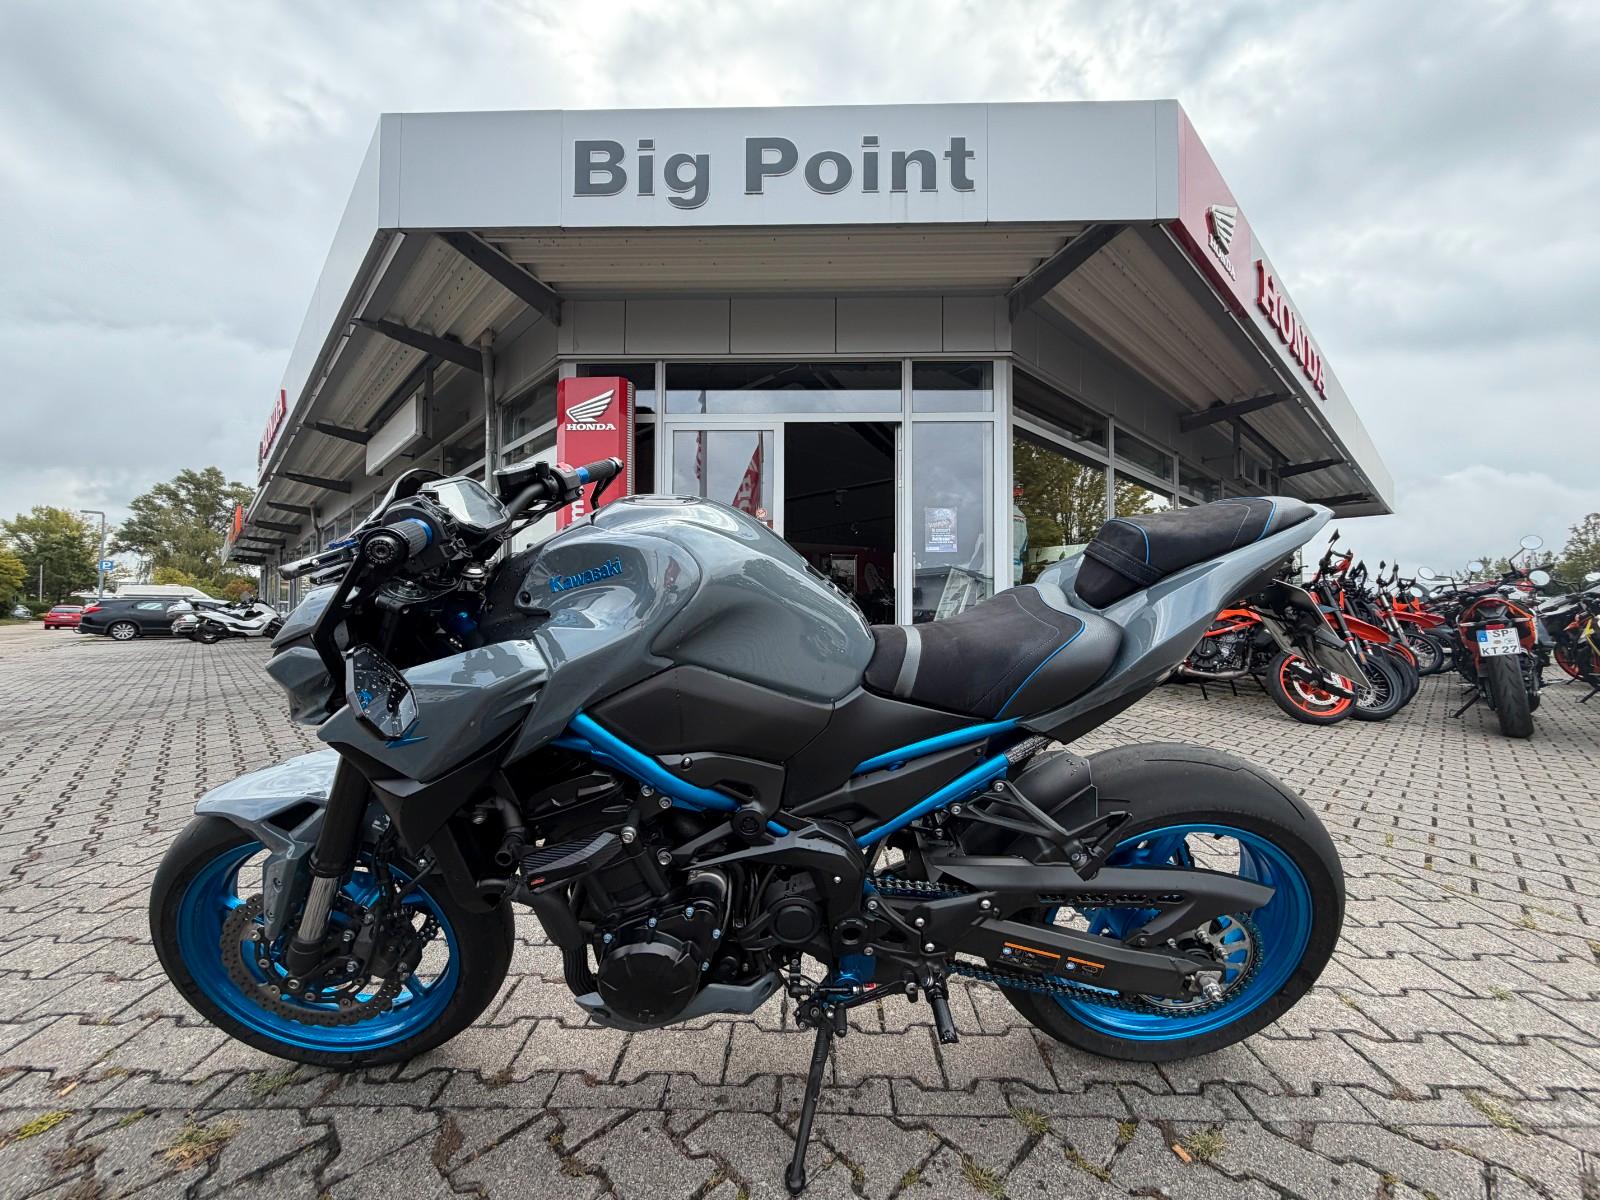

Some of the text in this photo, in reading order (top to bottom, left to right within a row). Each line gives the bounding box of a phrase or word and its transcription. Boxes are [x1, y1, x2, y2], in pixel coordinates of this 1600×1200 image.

[573, 135, 977, 210] Big Point
[1255, 259, 1327, 400] HONDA
[566, 423, 616, 431] HONDA
[549, 555, 622, 593] Kawasaki
[1492, 629, 1509, 638] SP
[1481, 645, 1517, 655] KT 27
